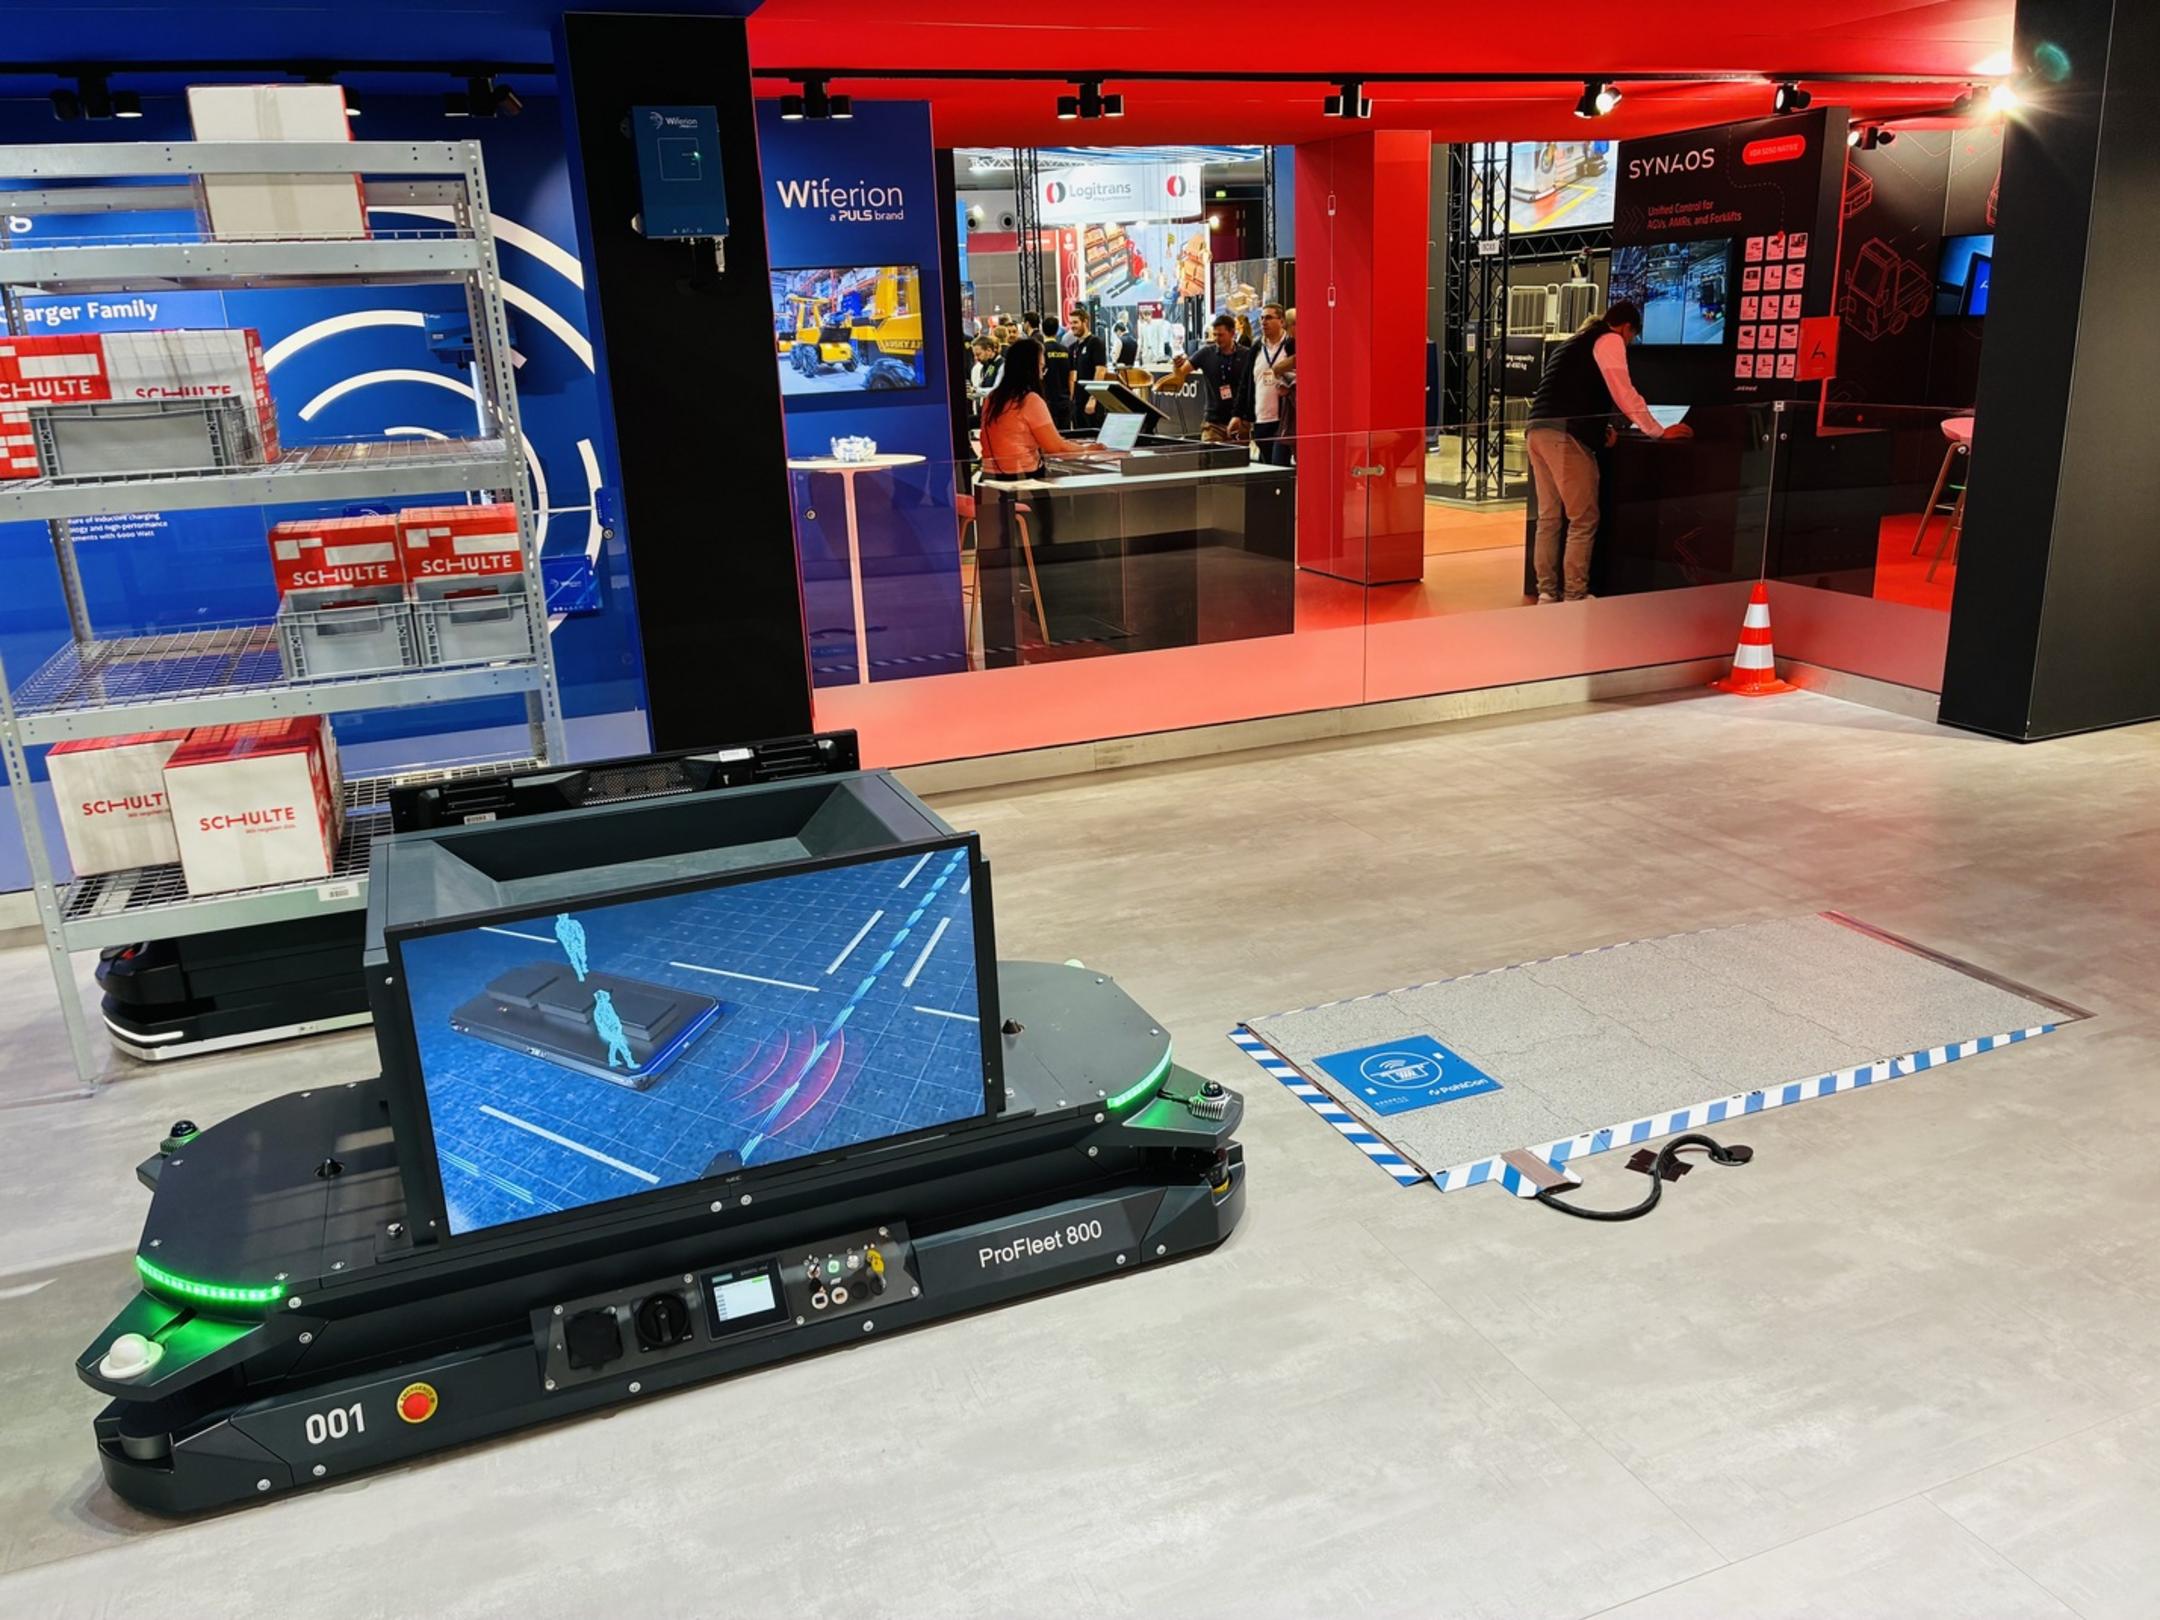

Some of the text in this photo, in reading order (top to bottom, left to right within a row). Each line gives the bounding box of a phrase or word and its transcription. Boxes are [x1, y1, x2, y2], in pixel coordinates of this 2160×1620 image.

[1628, 148, 1716, 180] SYNAOS
[776, 178, 904, 209] Wiferion
[1069, 181, 1132, 200] Logitrans
[830, 209, 904, 221] a PULS brand
[1675, 201, 1701, 213] Control
[1694, 214, 1708, 225] and
[86, 299, 158, 322] Family
[0, 378, 92, 399] CHULTE
[292, 564, 389, 586] SCHULTE
[421, 554, 512, 574] SCHULTE
[82, 792, 168, 816] SCHULT
[199, 807, 296, 831] SCHULTE
[979, 1220, 1102, 1268] ProFleet 800
[305, 1402, 365, 1445] 001
